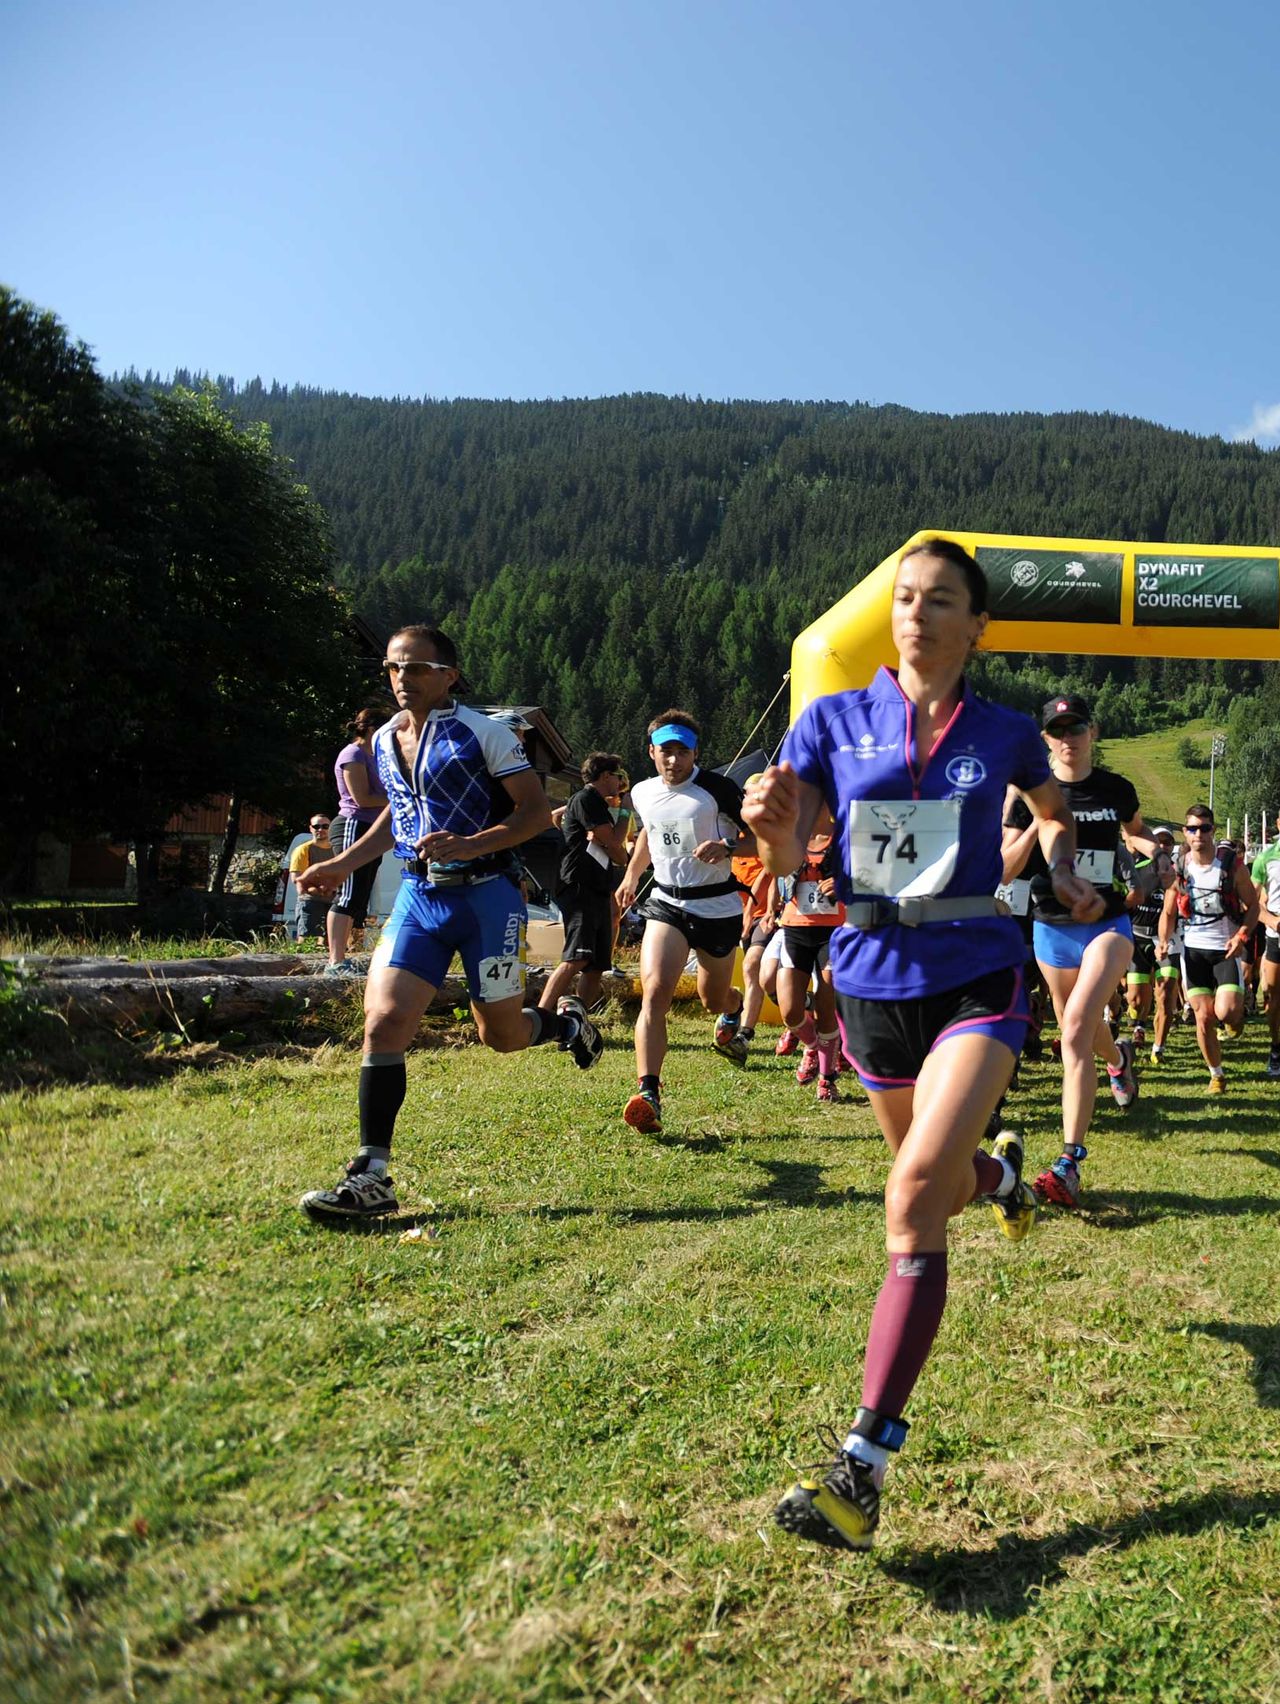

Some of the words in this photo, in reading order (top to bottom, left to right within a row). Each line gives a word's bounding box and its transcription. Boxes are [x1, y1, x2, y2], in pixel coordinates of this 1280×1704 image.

[1138, 562, 1204, 576] DYNAFIT
[1139, 577, 1158, 590] X2
[1137, 593, 1242, 609] COURCHEVEL
[663, 832, 681, 846] 86
[871, 833, 918, 864] 74
[1076, 850, 1095, 867] 71
[808, 892, 824, 904] 62
[486, 962, 513, 981] 47
